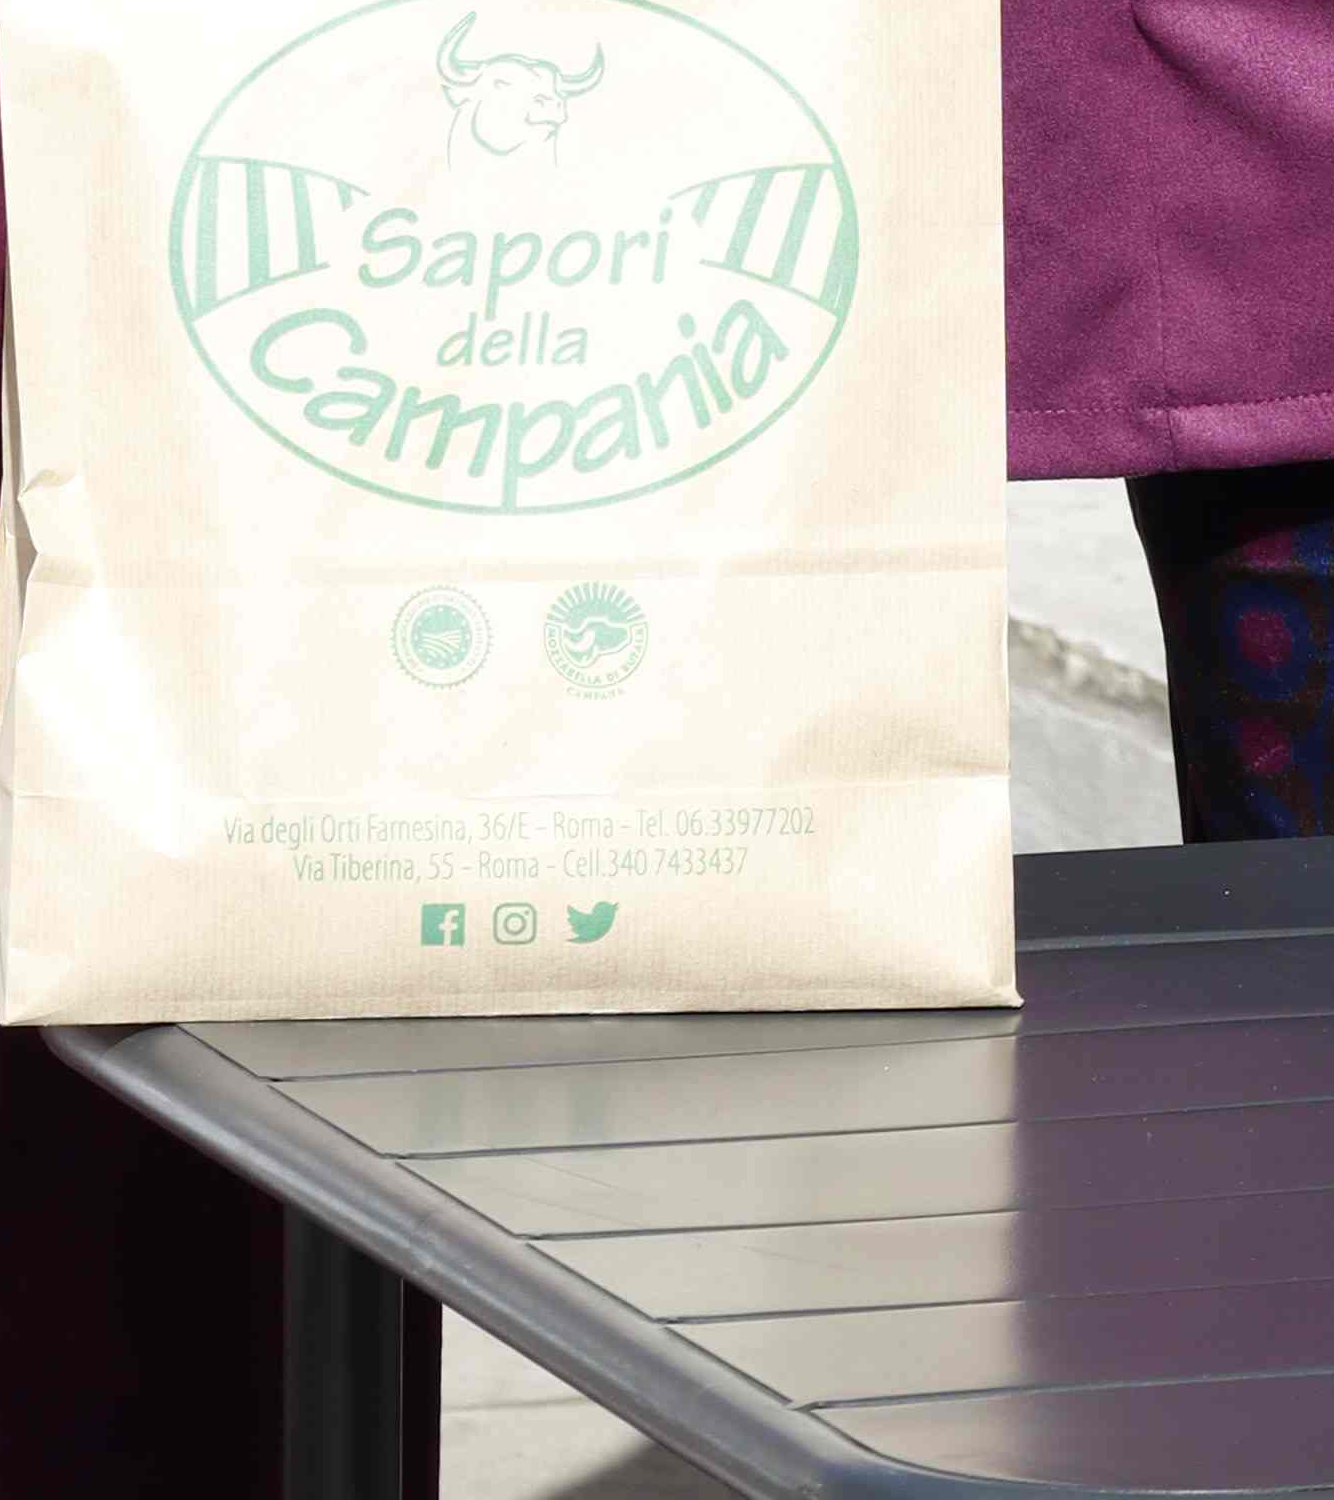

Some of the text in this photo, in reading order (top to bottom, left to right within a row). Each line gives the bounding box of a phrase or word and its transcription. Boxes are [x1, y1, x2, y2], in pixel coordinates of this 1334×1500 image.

[358, 206, 673, 321] Sapori
[436, 310, 588, 367] della
[249, 298, 790, 509] Campania
[224, 815, 255, 844] Via
[261, 814, 315, 851] degli
[321, 812, 361, 844] Orti
[479, 811, 531, 841] 36/E
[553, 811, 614, 839] Roma
[636, 809, 669, 838] Tel.
[676, 806, 815, 838] 06.33977202
[294, 853, 324, 882] Via
[330, 852, 421, 884] Tiberina,
[427, 851, 454, 880] 55
[478, 851, 539, 879] Roma
